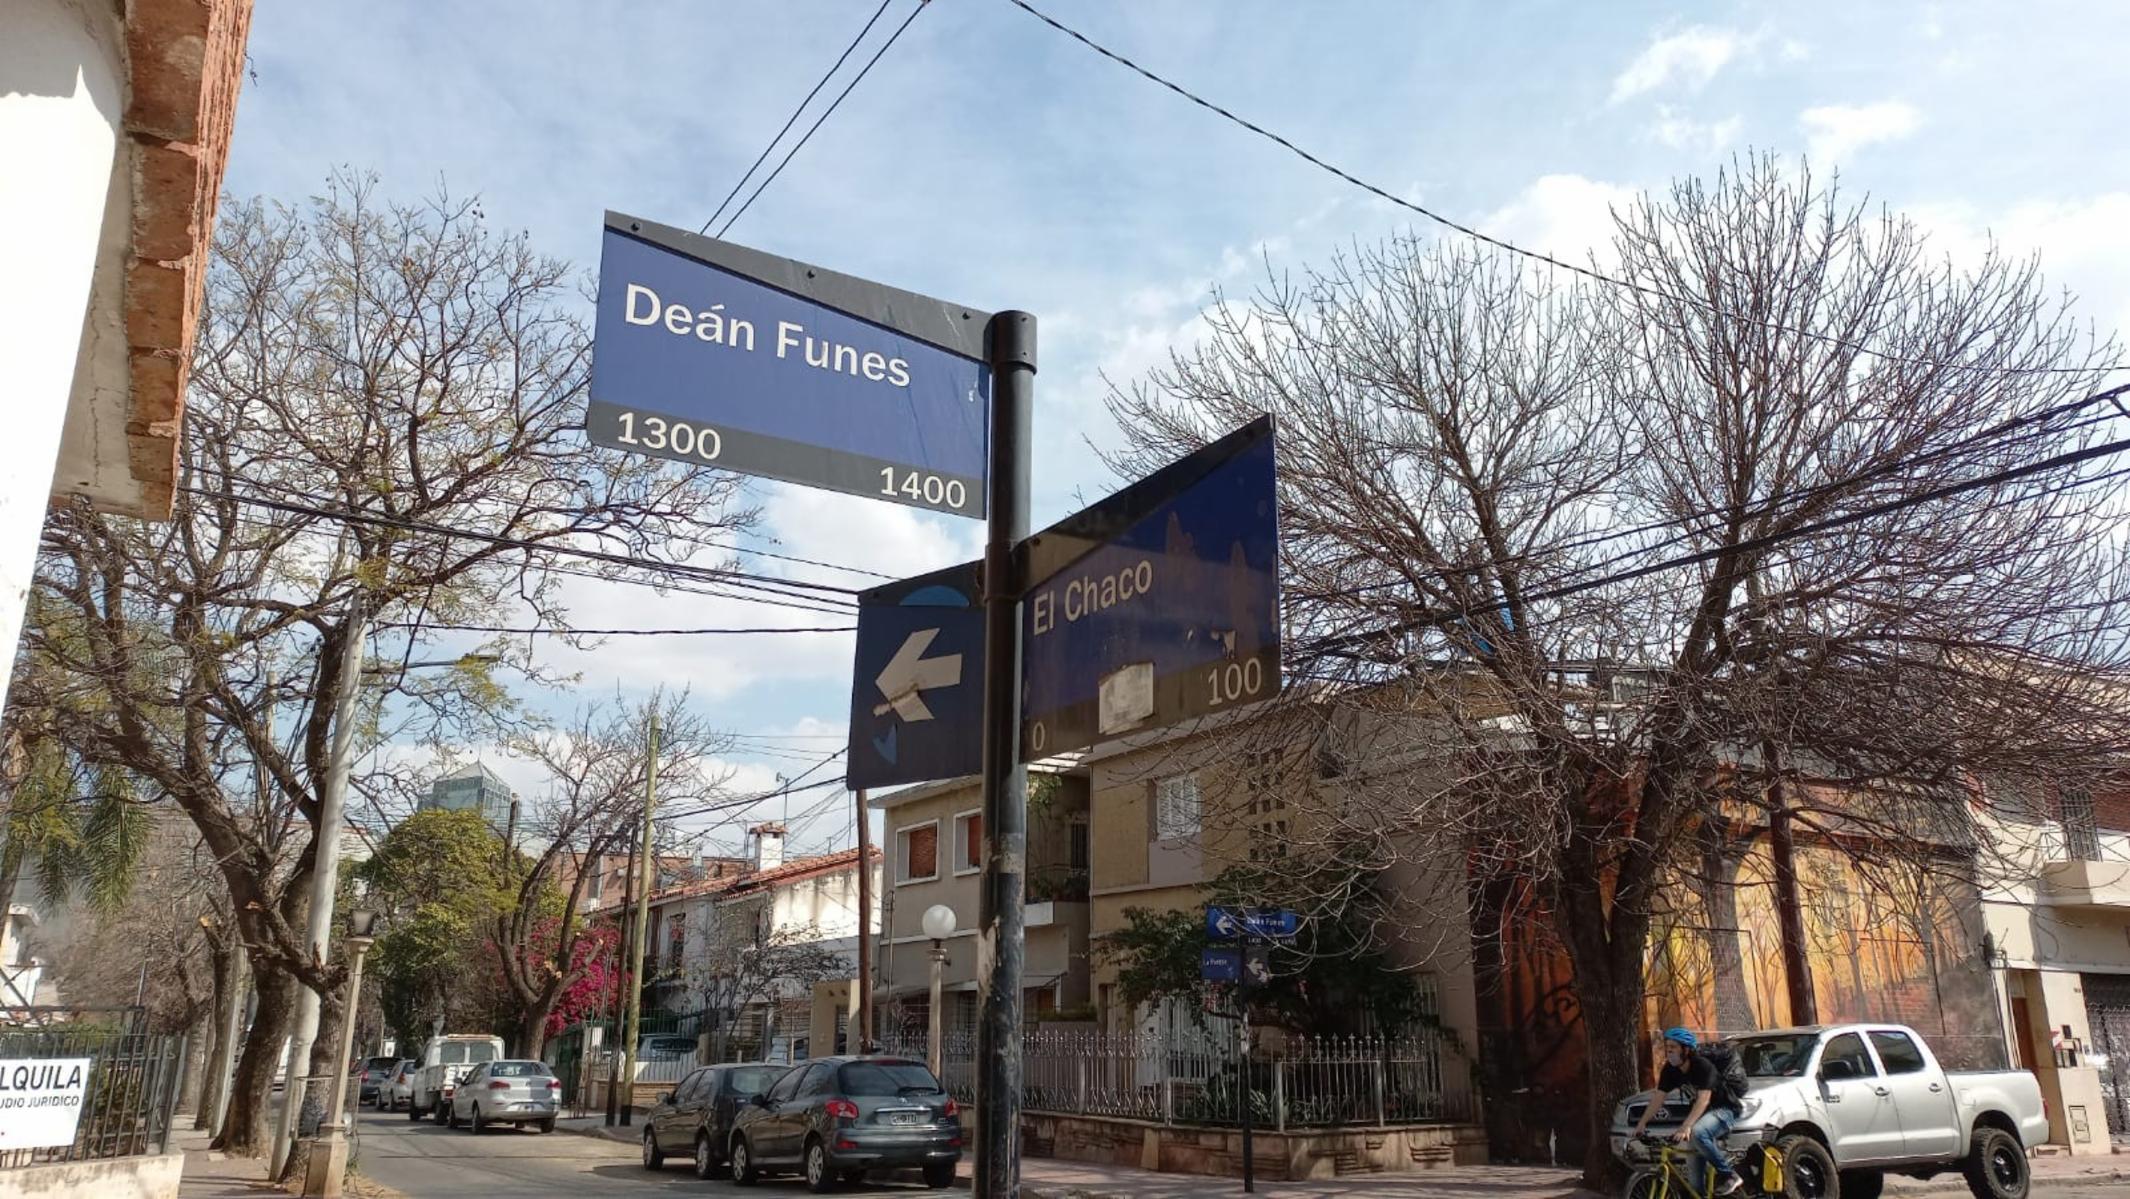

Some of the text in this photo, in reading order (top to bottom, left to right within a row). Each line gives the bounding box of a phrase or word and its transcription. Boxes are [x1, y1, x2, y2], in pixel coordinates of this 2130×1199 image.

[624, 282, 911, 387] Deán Funes
[617, 412, 722, 460] 1300
[880, 466, 966, 508] 1400
[1032, 560, 1153, 636] El Chaco
[1207, 657, 1262, 705] 100
[1032, 722, 1046, 752] 0
